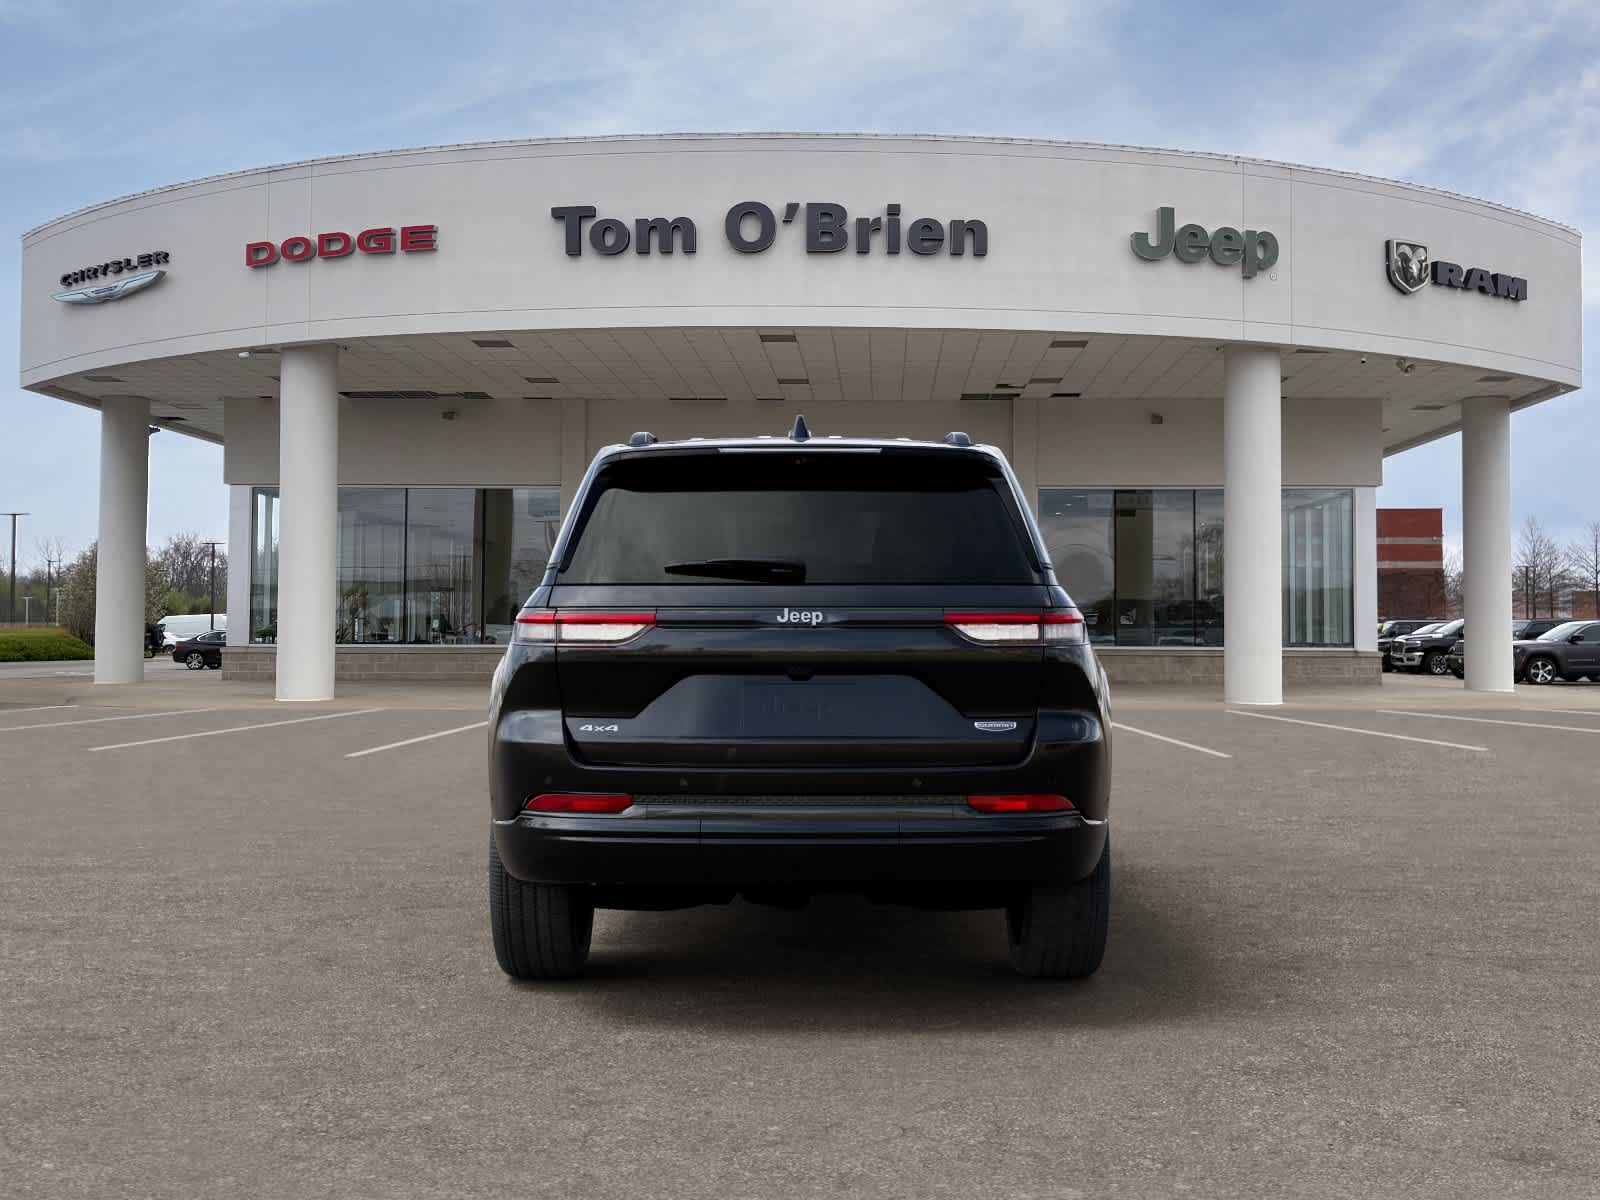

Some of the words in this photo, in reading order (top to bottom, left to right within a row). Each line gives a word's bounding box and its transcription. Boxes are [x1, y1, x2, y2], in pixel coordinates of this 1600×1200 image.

[245, 224, 438, 270] DODGE
[550, 205, 697, 257] Tom
[724, 201, 988, 257] O'Brien
[1129, 206, 1280, 279] Jeep
[60, 251, 170, 287] CHRYSLER
[1430, 259, 1528, 302] RAM
[776, 607, 824, 626] Jeep
